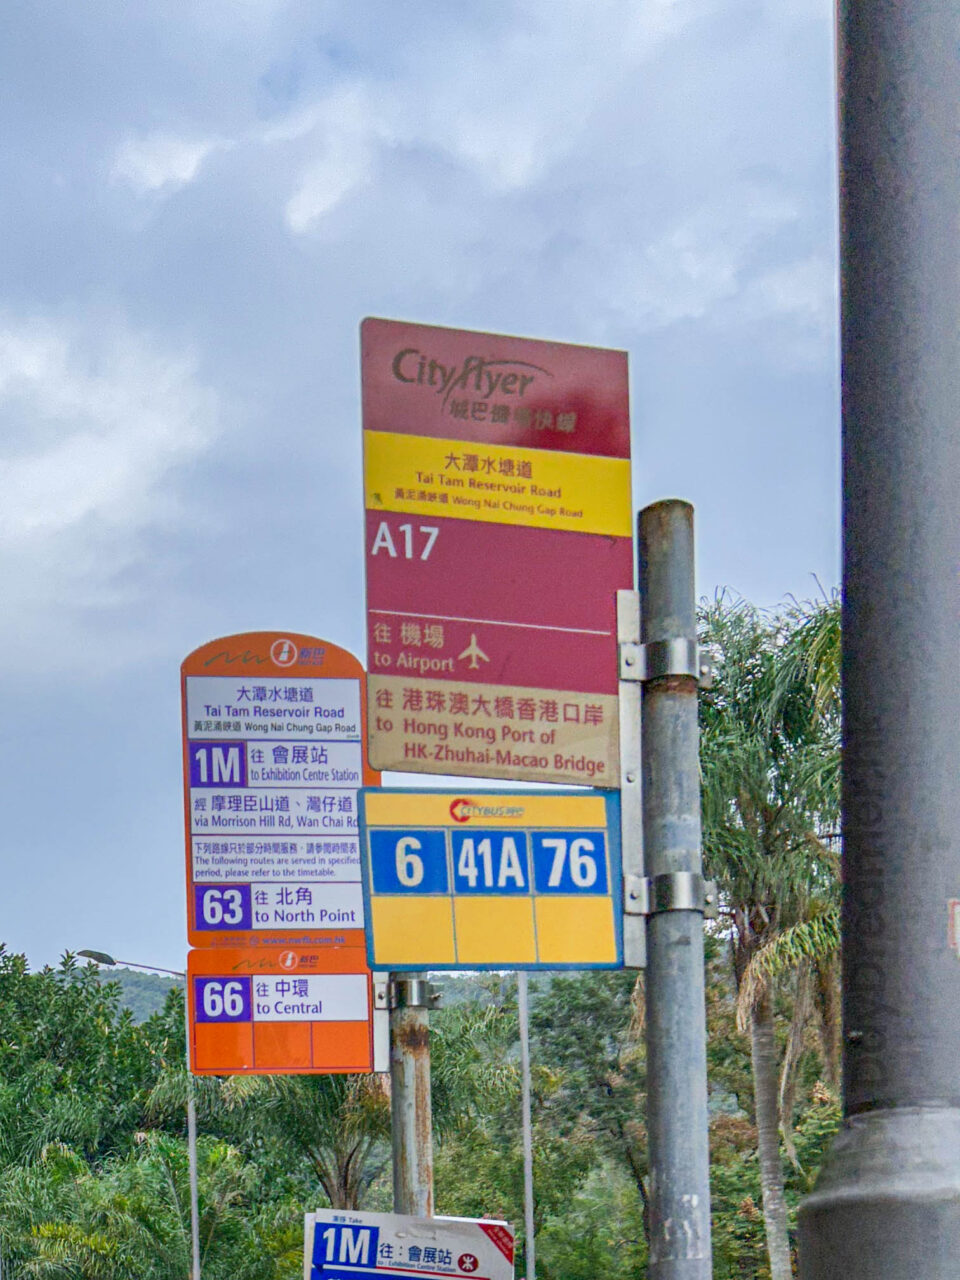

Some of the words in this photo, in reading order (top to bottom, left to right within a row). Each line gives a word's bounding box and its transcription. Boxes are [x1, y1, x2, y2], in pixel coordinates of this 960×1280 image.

[444, 452, 534, 479] 大潭水塘道
[416, 471, 434, 485] Tai
[439, 474, 465, 488] Tam
[468, 477, 527, 495] Reservoir
[530, 484, 562, 499] Road
[452, 495, 481, 510] Wong
[484, 498, 500, 510] Nai
[502, 499, 535, 516] Chung
[537, 505, 557, 518] Gap
[559, 507, 584, 519] Road
[371, 521, 440, 561] A17
[373, 623, 392, 644] 往
[400, 623, 445, 649] 機場
[373, 651, 391, 667] to
[396, 653, 455, 674] Airport
[236, 685, 314, 703] 大潭水塘道
[204, 704, 222, 717] Tai
[224, 704, 250, 717] Tam
[253, 705, 310, 718] Reservoir
[314, 706, 345, 718] Road
[375, 688, 394, 709] 往
[402, 687, 605, 726] 港珠澳大橋香港口岸
[244, 722, 269, 734] Wong
[270, 722, 285, 732] Nai
[286, 722, 314, 734] Chung
[316, 723, 333, 734] Gap
[335, 723, 356, 733] Road
[375, 716, 394, 733] to
[403, 718, 449, 740] Hong
[453, 721, 496, 744] Kong
[501, 725, 534, 743] Port
[540, 728, 556, 745] of
[195, 747, 240, 783] 1M
[250, 749, 265, 764] 往
[271, 745, 328, 765] 會展站
[403, 742, 549, 770] HK-Zhuhai-Macao
[553, 753, 606, 782] Bridge
[250, 769, 259, 781] to
[261, 768, 301, 781] Exhibition
[302, 769, 330, 782] Centre
[331, 769, 359, 782] Station
[194, 797, 207, 812] 經
[194, 815, 209, 828] via
[211, 815, 257, 828] Morrison
[259, 815, 275, 828] Hill
[278, 815, 294, 829] Rd,
[296, 816, 319, 828] Wan
[322, 815, 349, 828] Chai
[195, 856, 209, 865] The
[211, 856, 248, 867] following
[250, 856, 275, 865] routes
[277, 857, 289, 865] are
[291, 856, 316, 865] served
[318, 857, 326, 865] in
[195, 868, 223, 878] period,
[225, 868, 249, 879] please
[251, 868, 270, 877] refer
[272, 869, 281, 877] to
[282, 868, 295, 877] the
[297, 868, 336, 877] timetable.
[395, 836, 424, 887] 6
[458, 836, 526, 888] 41A
[542, 838, 598, 888] 76
[203, 889, 244, 925] 63
[254, 890, 269, 906] 往
[275, 887, 313, 906] 北角
[255, 910, 270, 923] to
[274, 909, 315, 923] North
[320, 909, 356, 922] Point
[203, 981, 244, 1018] 66
[256, 982, 270, 998] 往
[274, 978, 309, 999] 中環
[256, 1002, 271, 1015] to
[274, 1001, 323, 1015] Central
[322, 1226, 371, 1265] 1M
